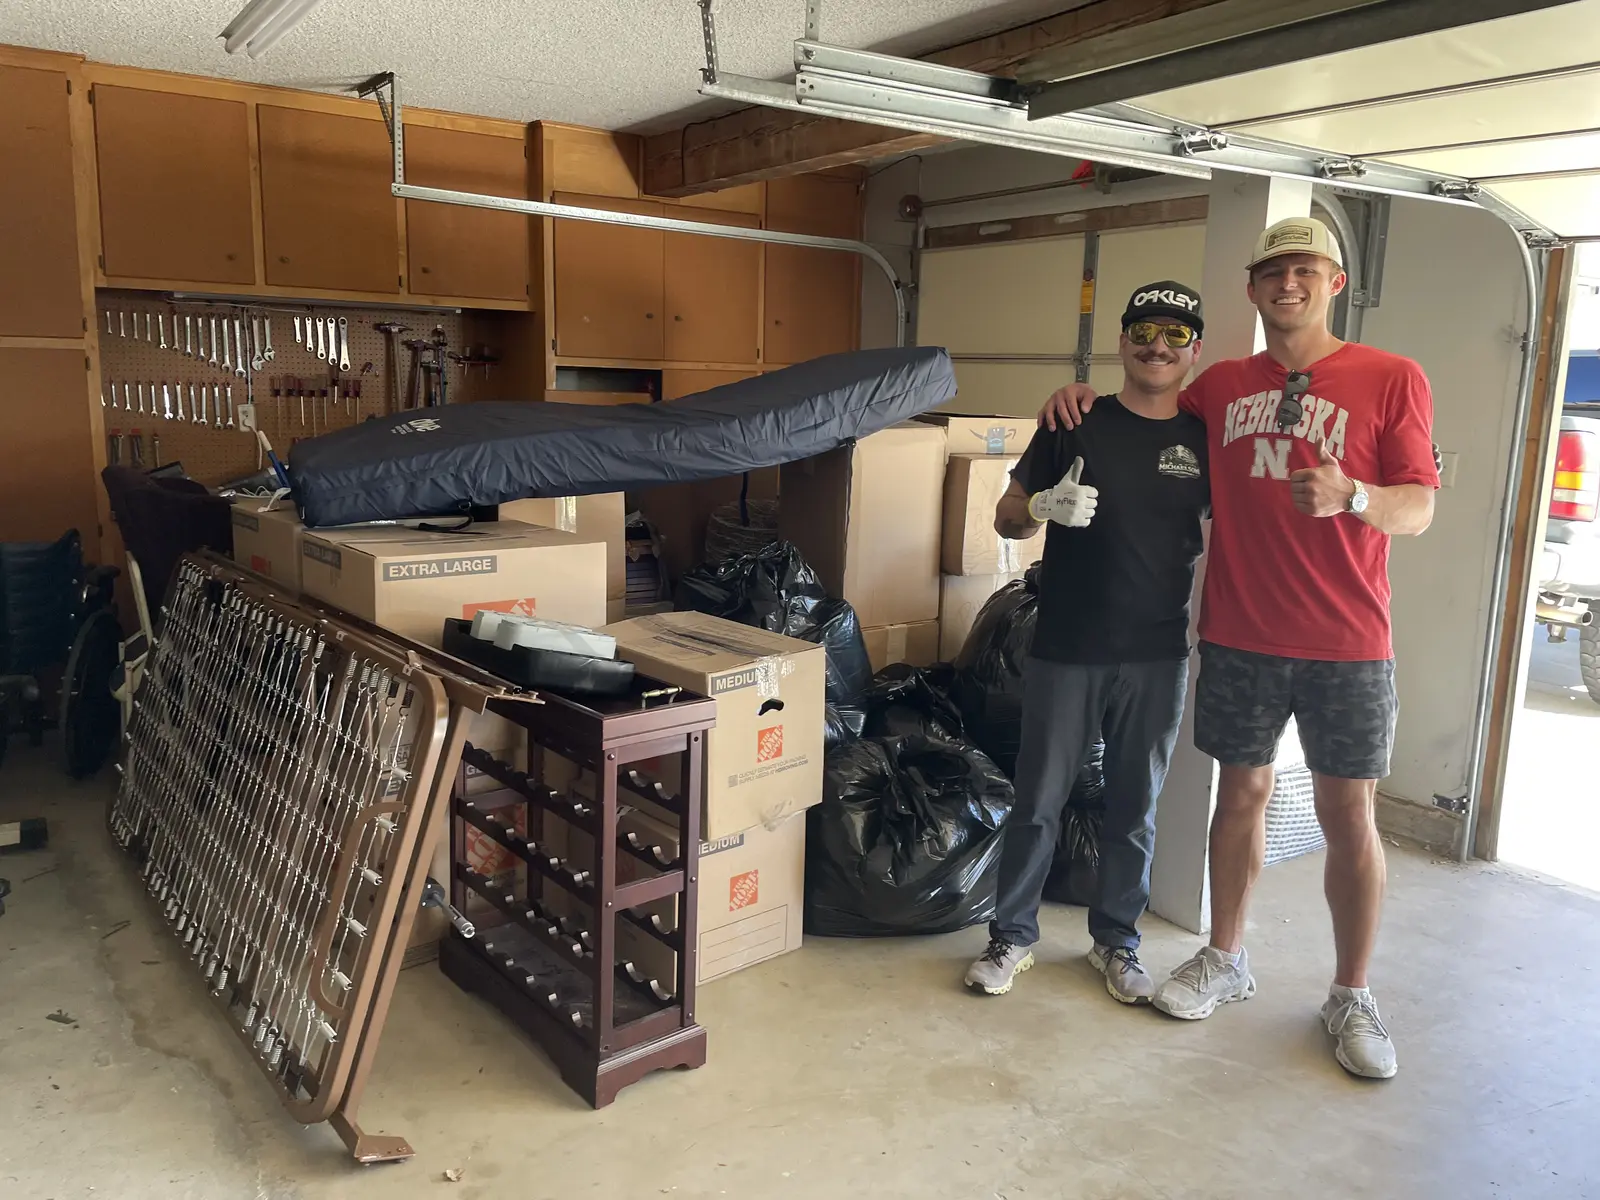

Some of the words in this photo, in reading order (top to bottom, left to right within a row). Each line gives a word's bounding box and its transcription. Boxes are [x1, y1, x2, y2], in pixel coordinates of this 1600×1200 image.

[1133, 289, 1199, 311] OAKLEY
[1249, 437, 1292, 480] N
[389, 563, 439, 577] EXTRA
[443, 559, 492, 573] LARGE
[698, 834, 740, 855] EDIUM
